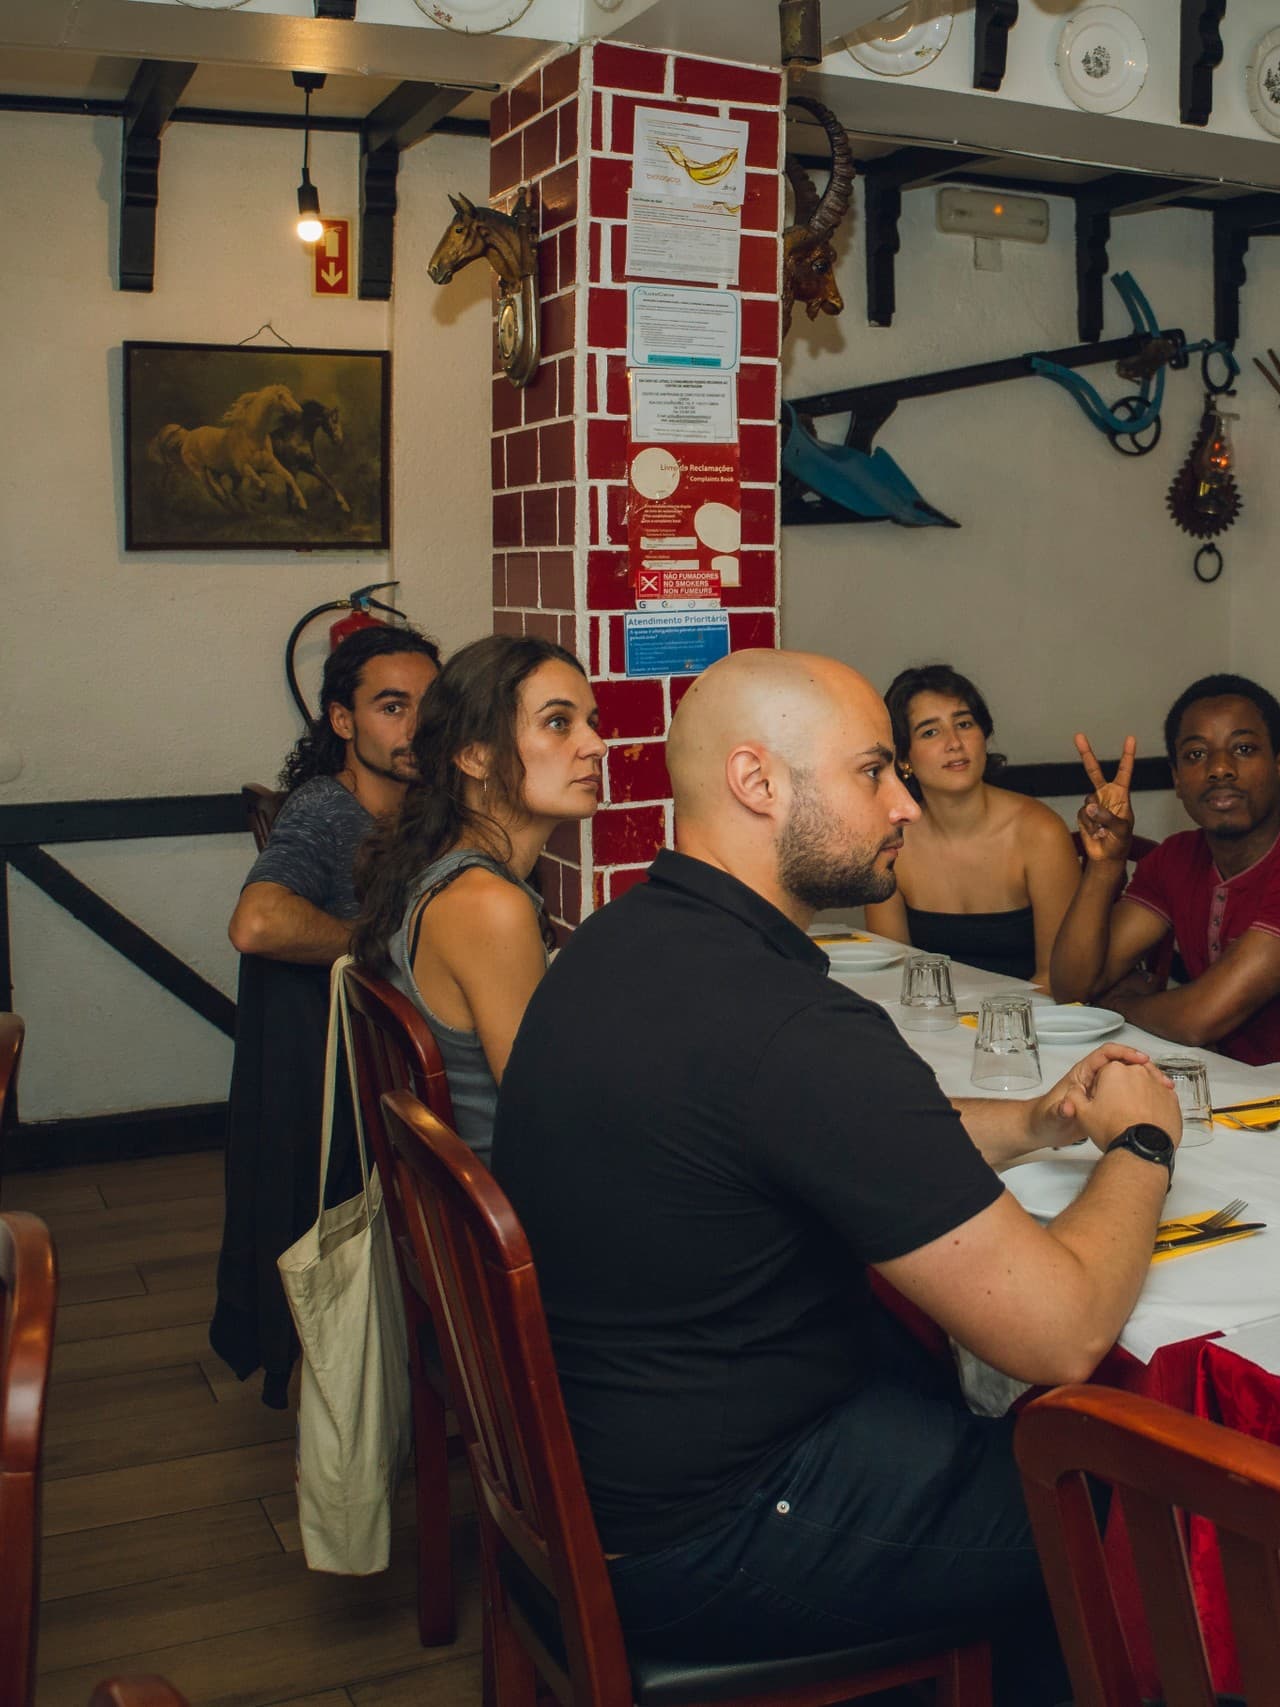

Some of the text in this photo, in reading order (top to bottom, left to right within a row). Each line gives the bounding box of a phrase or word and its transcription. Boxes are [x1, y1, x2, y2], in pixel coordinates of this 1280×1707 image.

[689, 463, 734, 473] Reclamações
[663, 571, 678, 579] NÃO
[628, 615, 728, 626] Atendimento Prioritário
